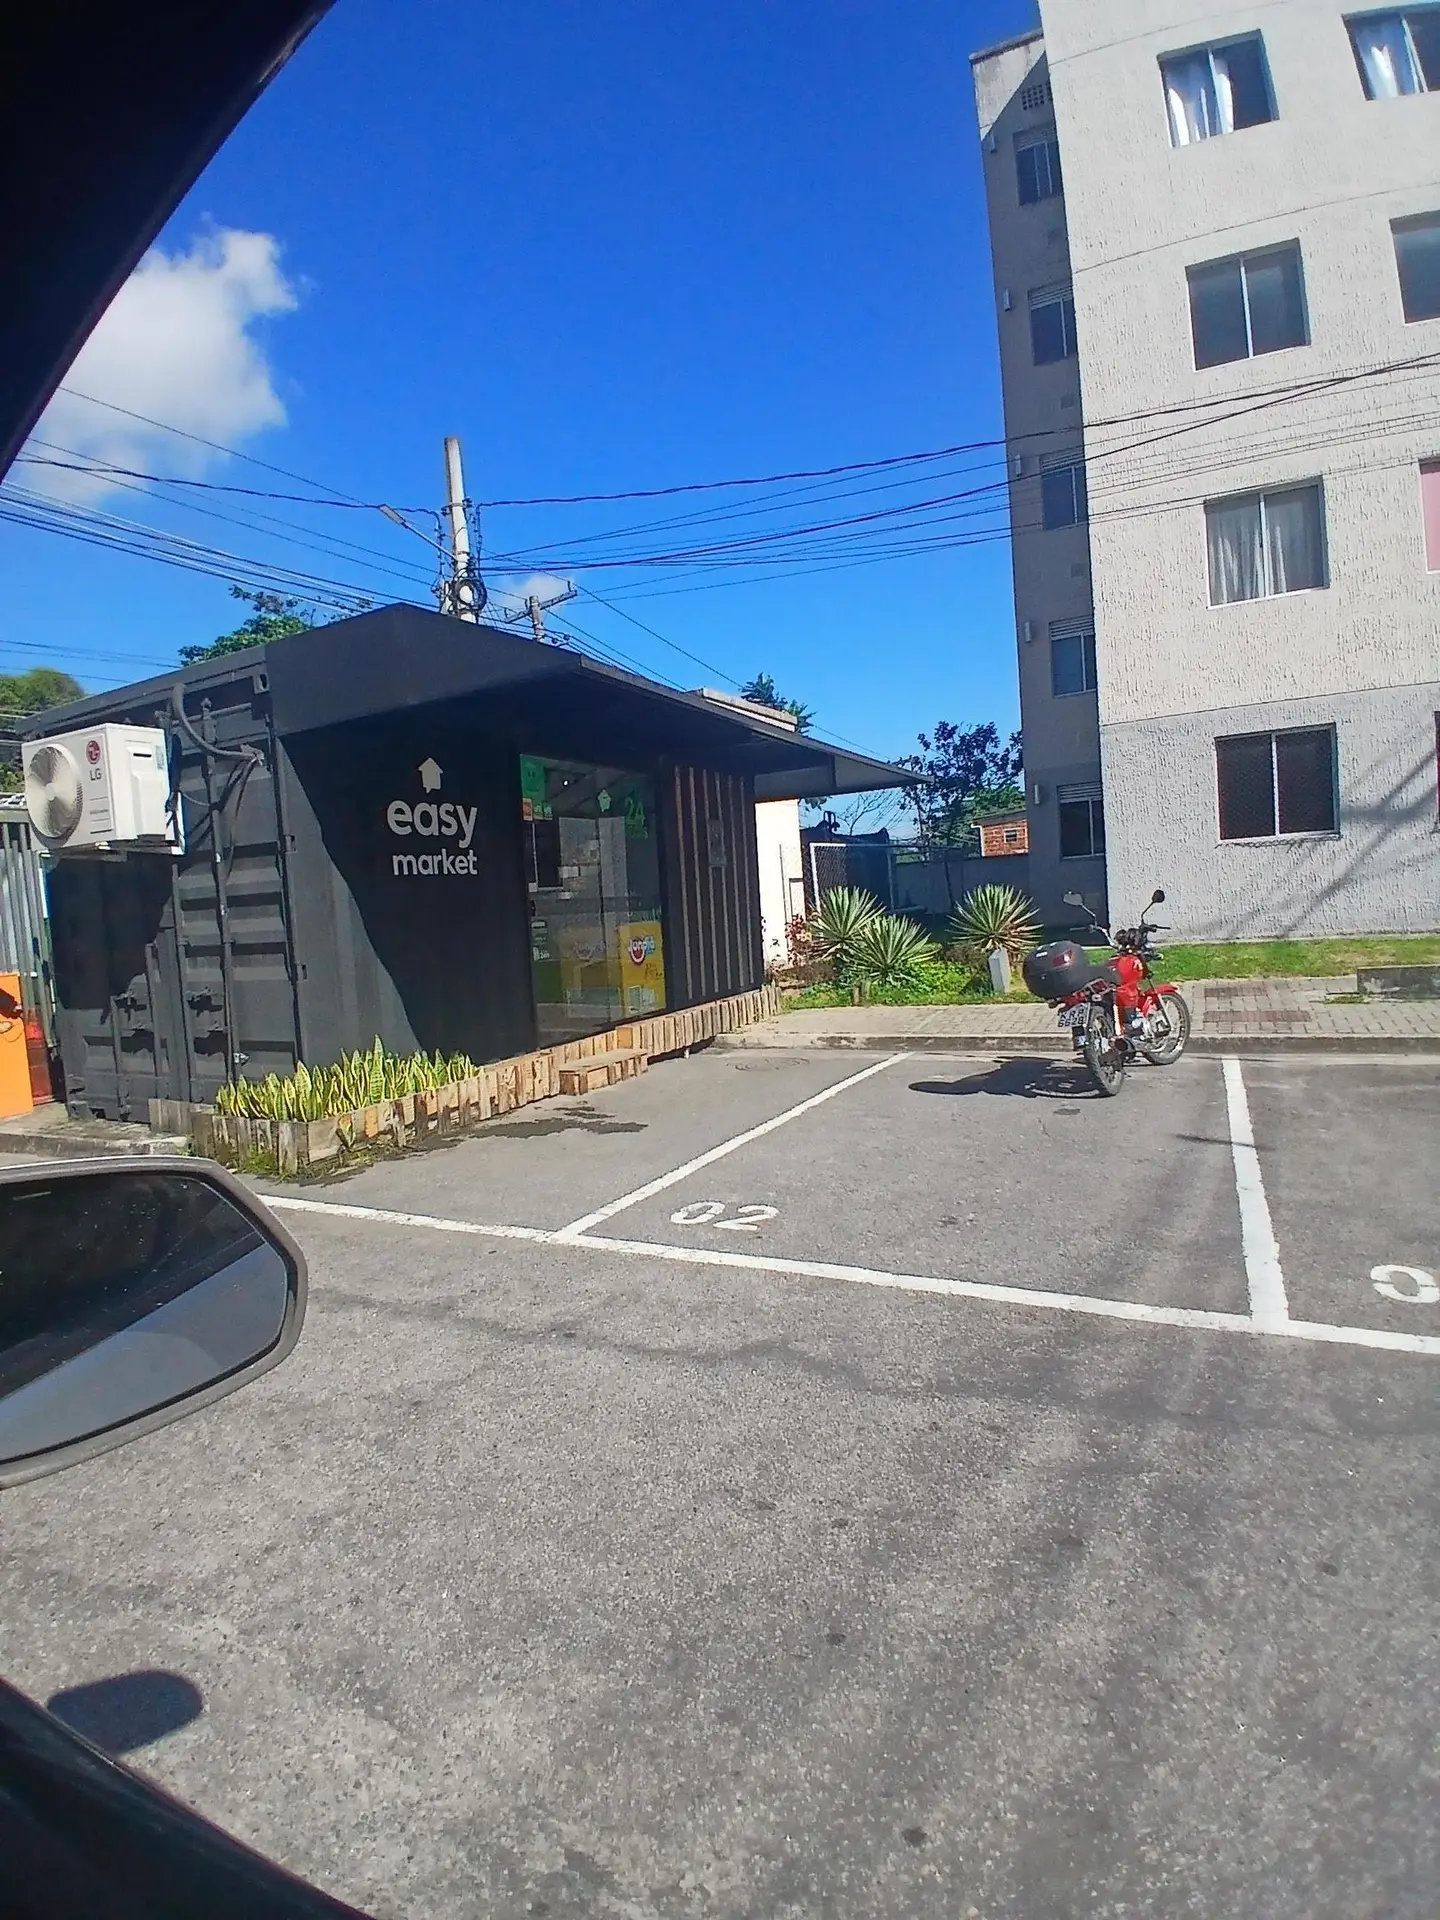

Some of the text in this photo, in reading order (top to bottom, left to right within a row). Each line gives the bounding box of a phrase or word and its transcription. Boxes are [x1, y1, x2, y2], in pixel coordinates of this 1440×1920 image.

[89, 768, 102, 781] LG
[387, 800, 478, 848] easy
[392, 848, 478, 875] market
[670, 1201, 779, 1231] 02
[1370, 1264, 1440, 1303] 0
